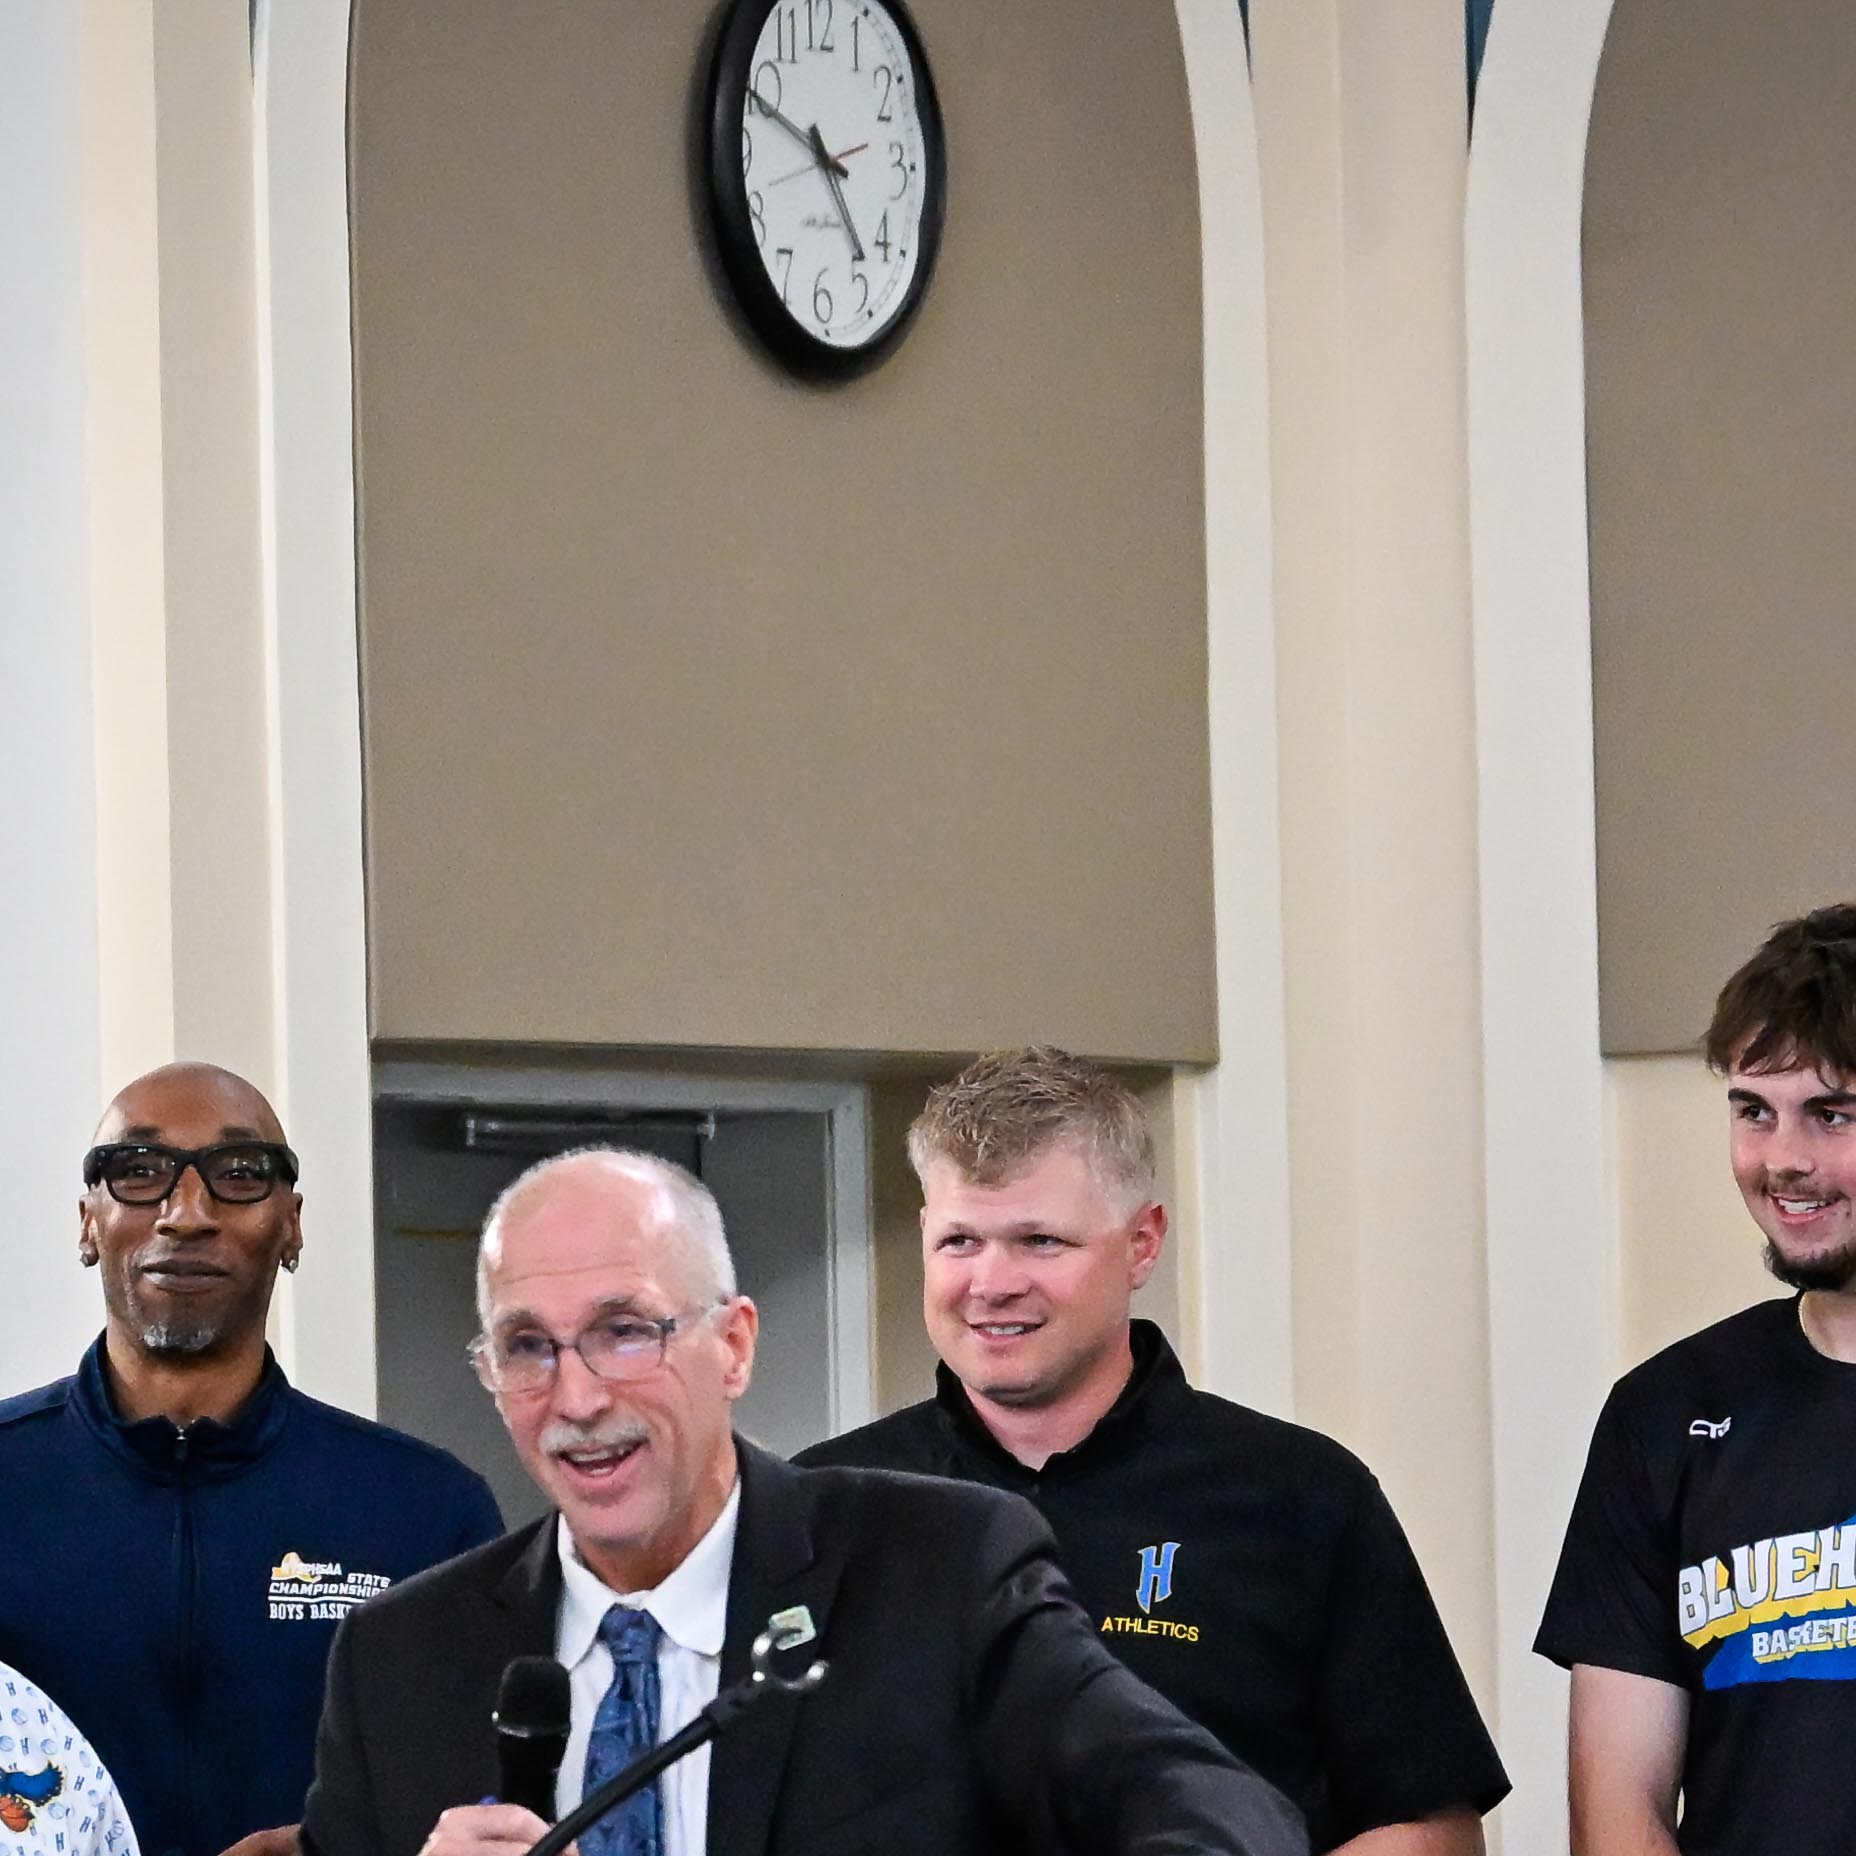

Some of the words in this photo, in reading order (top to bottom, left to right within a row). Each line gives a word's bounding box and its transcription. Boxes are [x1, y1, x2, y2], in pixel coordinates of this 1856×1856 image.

[775, 6, 798, 64] 11
[851, 15, 861, 73] 1
[873, 65, 893, 122] 2
[889, 142, 908, 201] 3
[874, 208, 892, 263] 4
[776, 248, 794, 305] 7
[813, 267, 833, 324] 6
[851, 254, 868, 314] 5
[269, 1582, 386, 1598] CHAMPIONSHIP
[347, 1572, 391, 1588] STATE
[1135, 1541, 1182, 1615] H
[269, 1603, 304, 1620] BOYS
[1101, 1615, 1200, 1642] ATHLETICS
